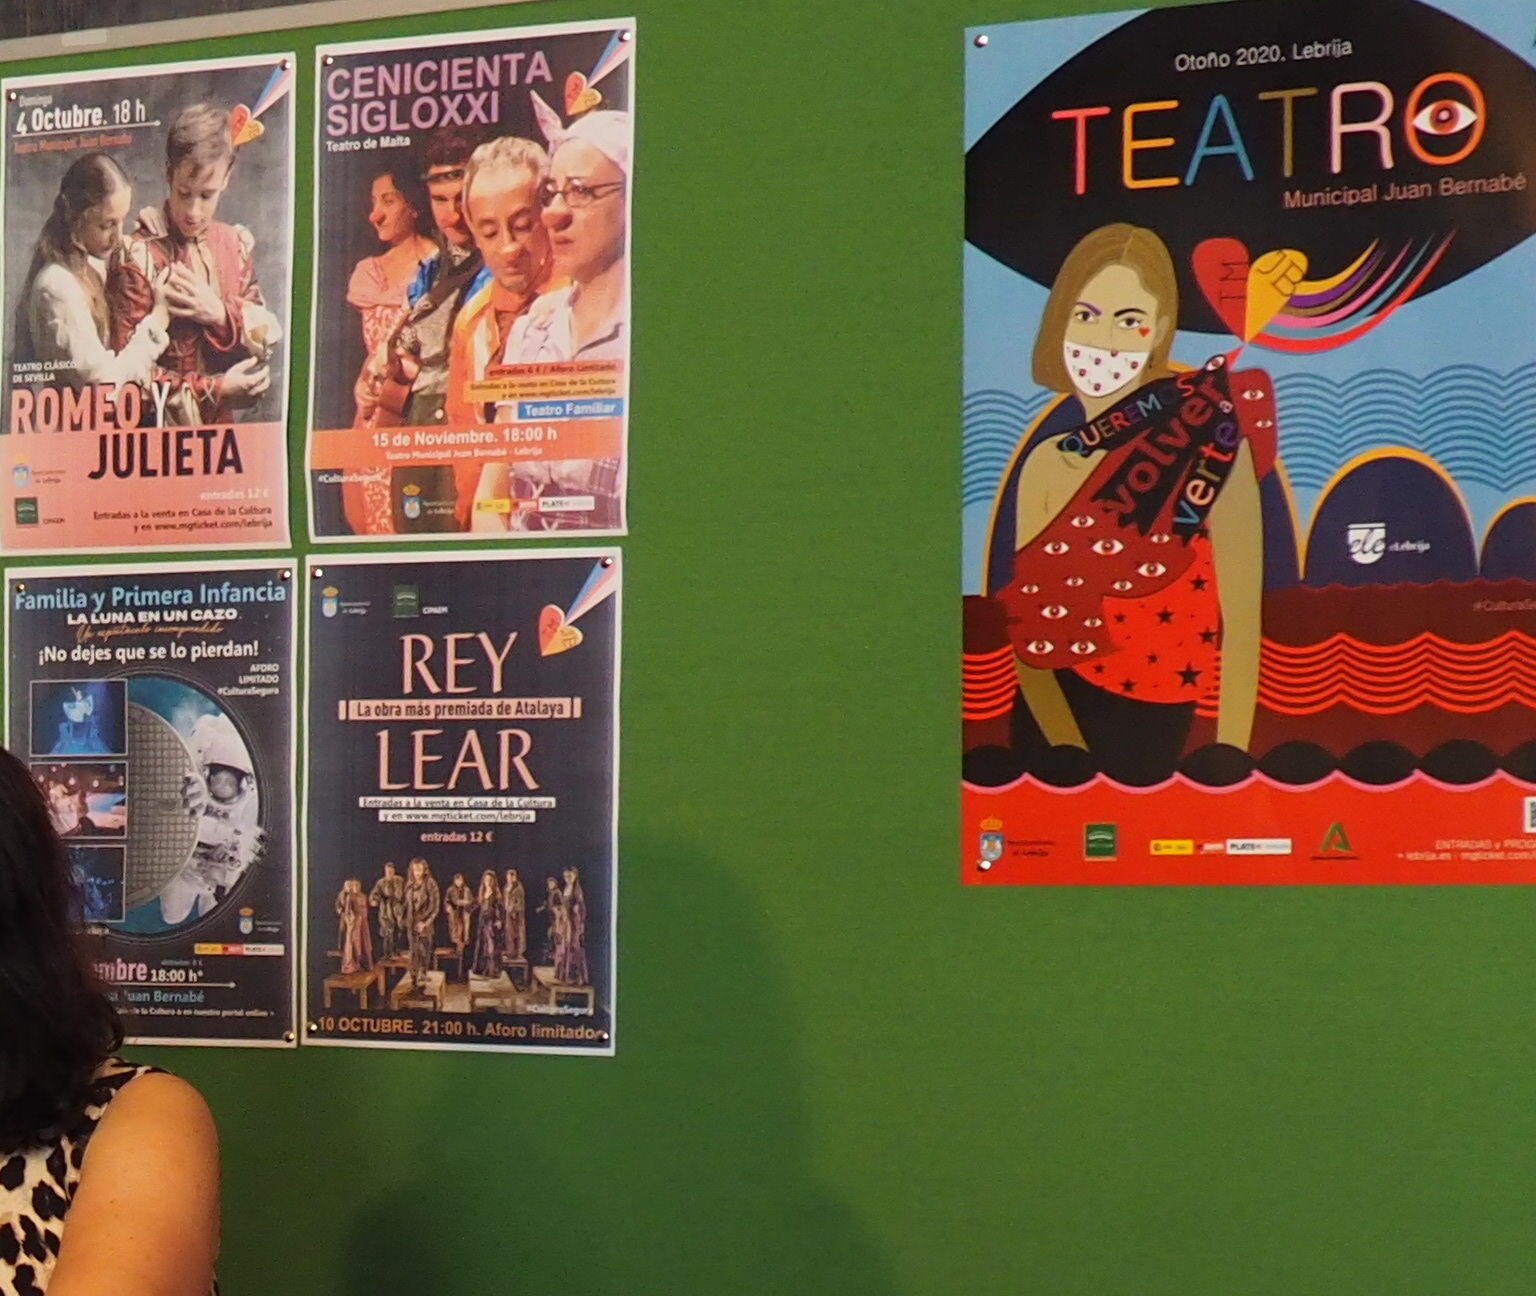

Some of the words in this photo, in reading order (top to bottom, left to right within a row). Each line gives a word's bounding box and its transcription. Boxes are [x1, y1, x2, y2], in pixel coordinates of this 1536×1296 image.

[1174, 50, 1231, 73] Otoño
[1236, 44, 1287, 66] 2020.
[1292, 38, 1354, 62] Lebrija
[327, 51, 553, 101] CENICIENTA
[16, 113, 28, 135] 4
[31, 105, 108, 132] Octubre.
[113, 99, 131, 125] 18
[136, 98, 146, 122] h
[326, 91, 500, 137] SIGLOXXI
[1051, 71, 1487, 195] TEATRO
[326, 139, 361, 152] Teatro
[363, 138, 377, 149] de
[380, 136, 411, 148] Malta
[1283, 183, 1378, 209] Municipal
[1383, 180, 1433, 203] Juan
[1439, 171, 1527, 197] Bernabé
[13, 362, 43, 373] TEATRO
[44, 359, 77, 371] CLÁSICO
[13, 374, 23, 383] DE
[24, 373, 55, 383] SEVILLA
[10, 383, 141, 434] ROMEO
[151, 381, 171, 428] Y
[525, 404, 563, 417] Teatro
[565, 402, 616, 415] Familiar
[1219, 400, 1233, 414] a
[372, 433, 389, 447] 15
[392, 431, 410, 446] de
[414, 429, 498, 445] Noviembre.
[503, 428, 542, 442] 18:00
[547, 428, 557, 441] h
[88, 429, 244, 480] JULIETA
[93, 510, 131, 520] Entradas
[152, 509, 176, 518] venta
[179, 509, 189, 517] en
[192, 507, 212, 517] Casa
[215, 507, 226, 517] de
[239, 504, 272, 515] Cultura
[15, 588, 89, 610] Familia
[91, 593, 105, 612] y
[112, 585, 193, 608] Primera
[200, 580, 287, 604] Infancia
[67, 613, 89, 625] LA
[91, 612, 136, 624] LUNA
[138, 612, 160, 623] EN
[163, 611, 189, 622] UN
[191, 609, 238, 621] CAZO
[71, 645, 111, 665] dejes
[116, 646, 146, 664] que
[149, 644, 167, 659] se
[171, 642, 186, 658] lo
[191, 640, 259, 662] pierdan!
[399, 631, 519, 695] REY
[357, 702, 372, 717] La
[375, 702, 402, 716] obra
[405, 700, 431, 716] más
[435, 701, 493, 720] premiada
[496, 700, 513, 715] de
[515, 700, 564, 718] Atalaya
[375, 728, 540, 791] LEAR
[363, 799, 402, 807] Entradas
[425, 799, 450, 807] venta
[467, 799, 488, 807] Casa
[491, 799, 503, 807] de
[517, 798, 553, 807] Cultura
[421, 832, 467, 843] entradas
[470, 832, 483, 843] 12
[151, 970, 185, 982] 18:00
[154, 990, 204, 1003] Bernabé
[338, 1018, 418, 1035] OCTUBRE.
[422, 1020, 462, 1035] 21:00
[485, 1023, 527, 1038] Aforo
